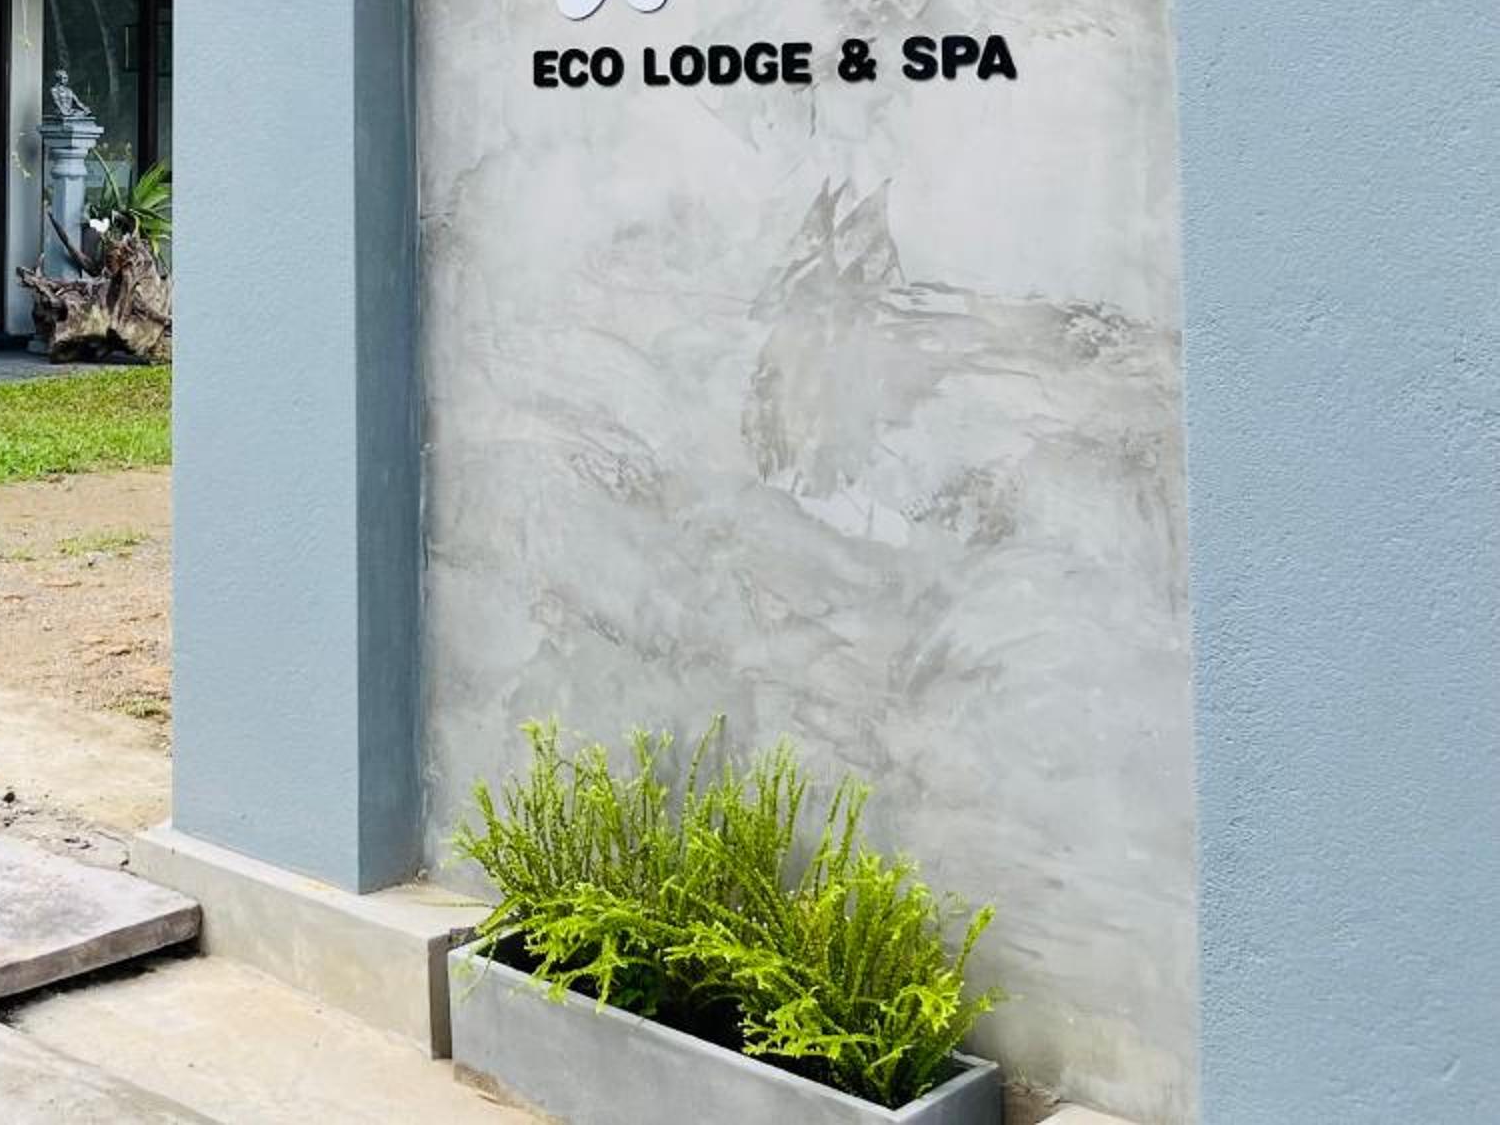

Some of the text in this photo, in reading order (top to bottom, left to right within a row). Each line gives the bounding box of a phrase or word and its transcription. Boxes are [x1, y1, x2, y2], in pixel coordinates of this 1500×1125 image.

[533, 34, 1018, 89] ECO LODGE & SPA
